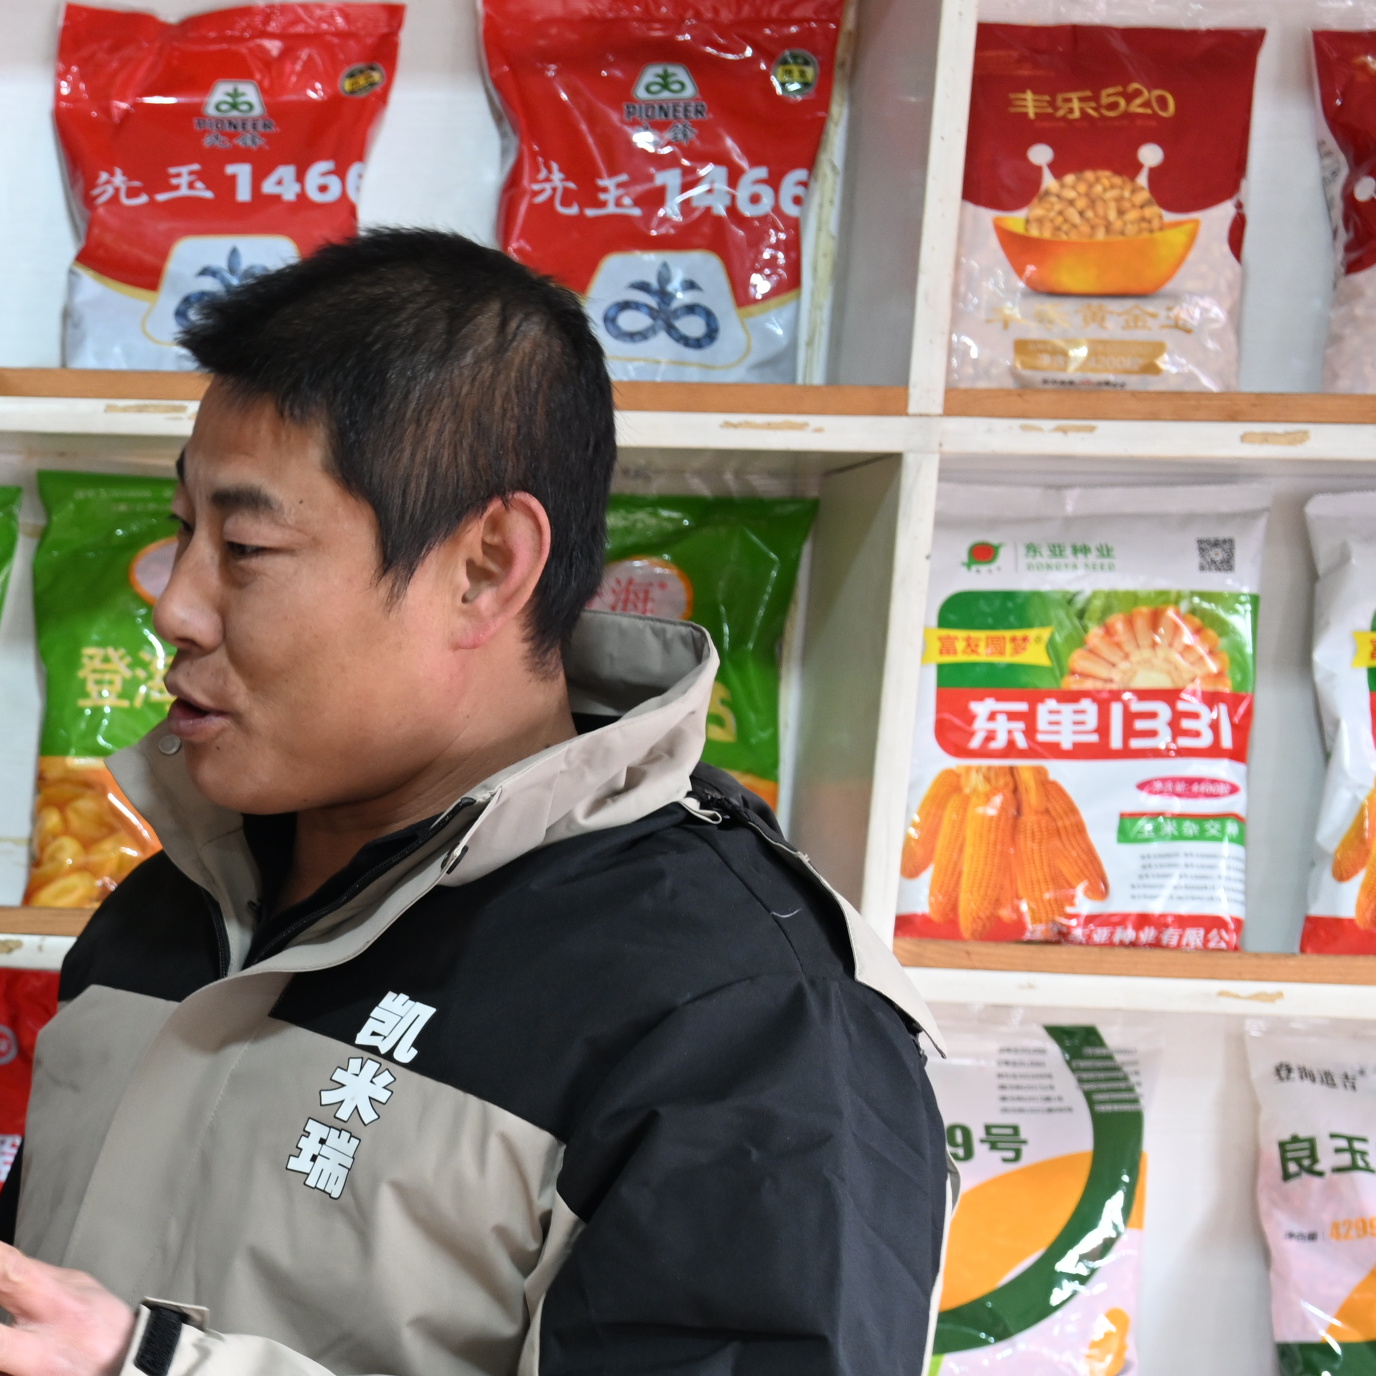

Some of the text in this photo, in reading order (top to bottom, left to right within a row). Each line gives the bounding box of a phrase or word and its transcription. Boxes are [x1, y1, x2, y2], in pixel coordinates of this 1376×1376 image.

[624, 103, 708, 121] PIONEER
[1008, 82, 1176, 120] 丰乐520
[194, 117, 276, 132] PIONEER
[1024, 542, 1116, 560] 东亚种业
[967, 697, 1234, 752] 东单1331
[285, 990, 438, 1200] 凯米瑞
